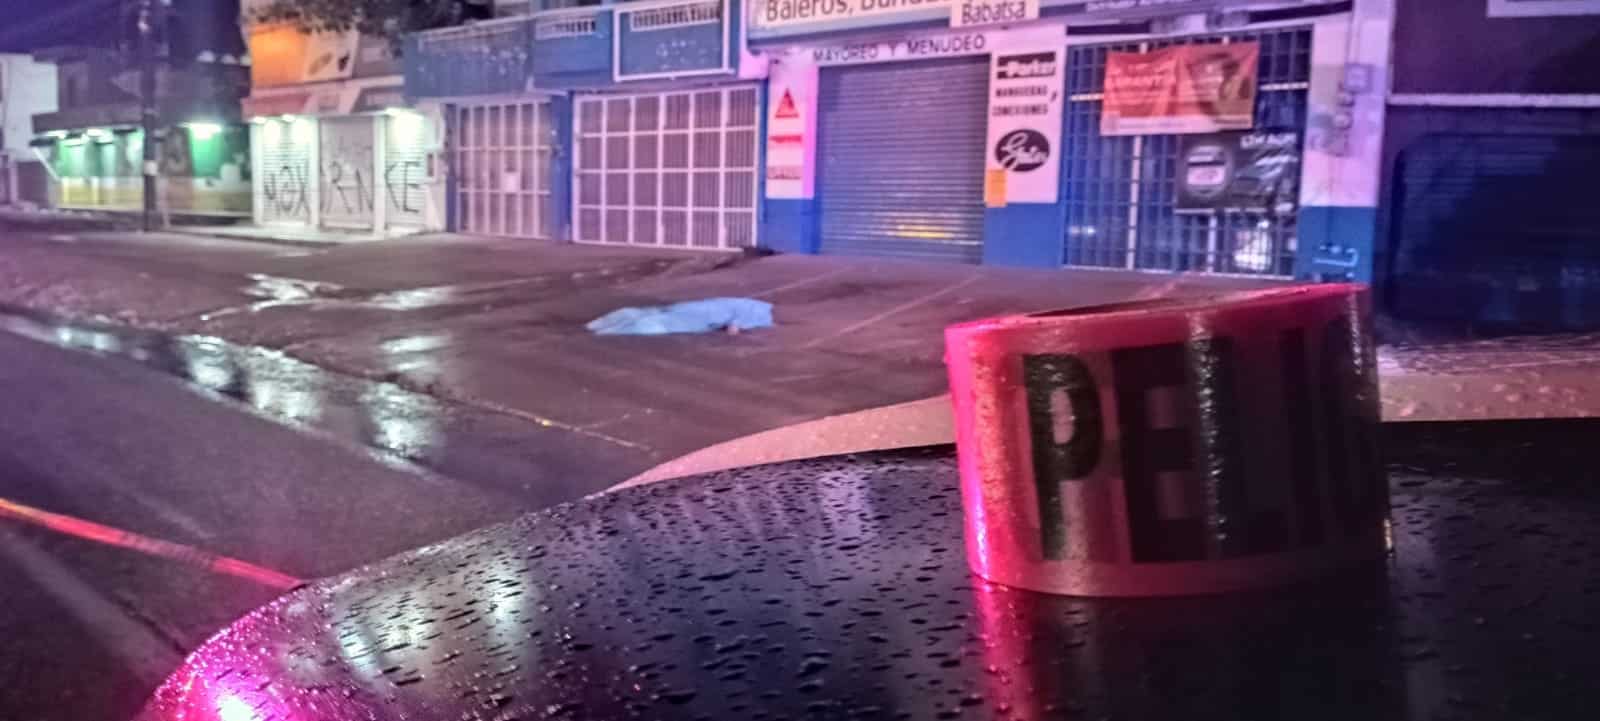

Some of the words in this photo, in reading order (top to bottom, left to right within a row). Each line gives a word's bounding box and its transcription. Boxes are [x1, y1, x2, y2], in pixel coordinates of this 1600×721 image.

[962, 1, 1025, 24] Babatsa
[813, 42, 879, 61] MAYOREO
[888, 40, 898, 56] Y
[907, 35, 986, 54] MENUDEO
